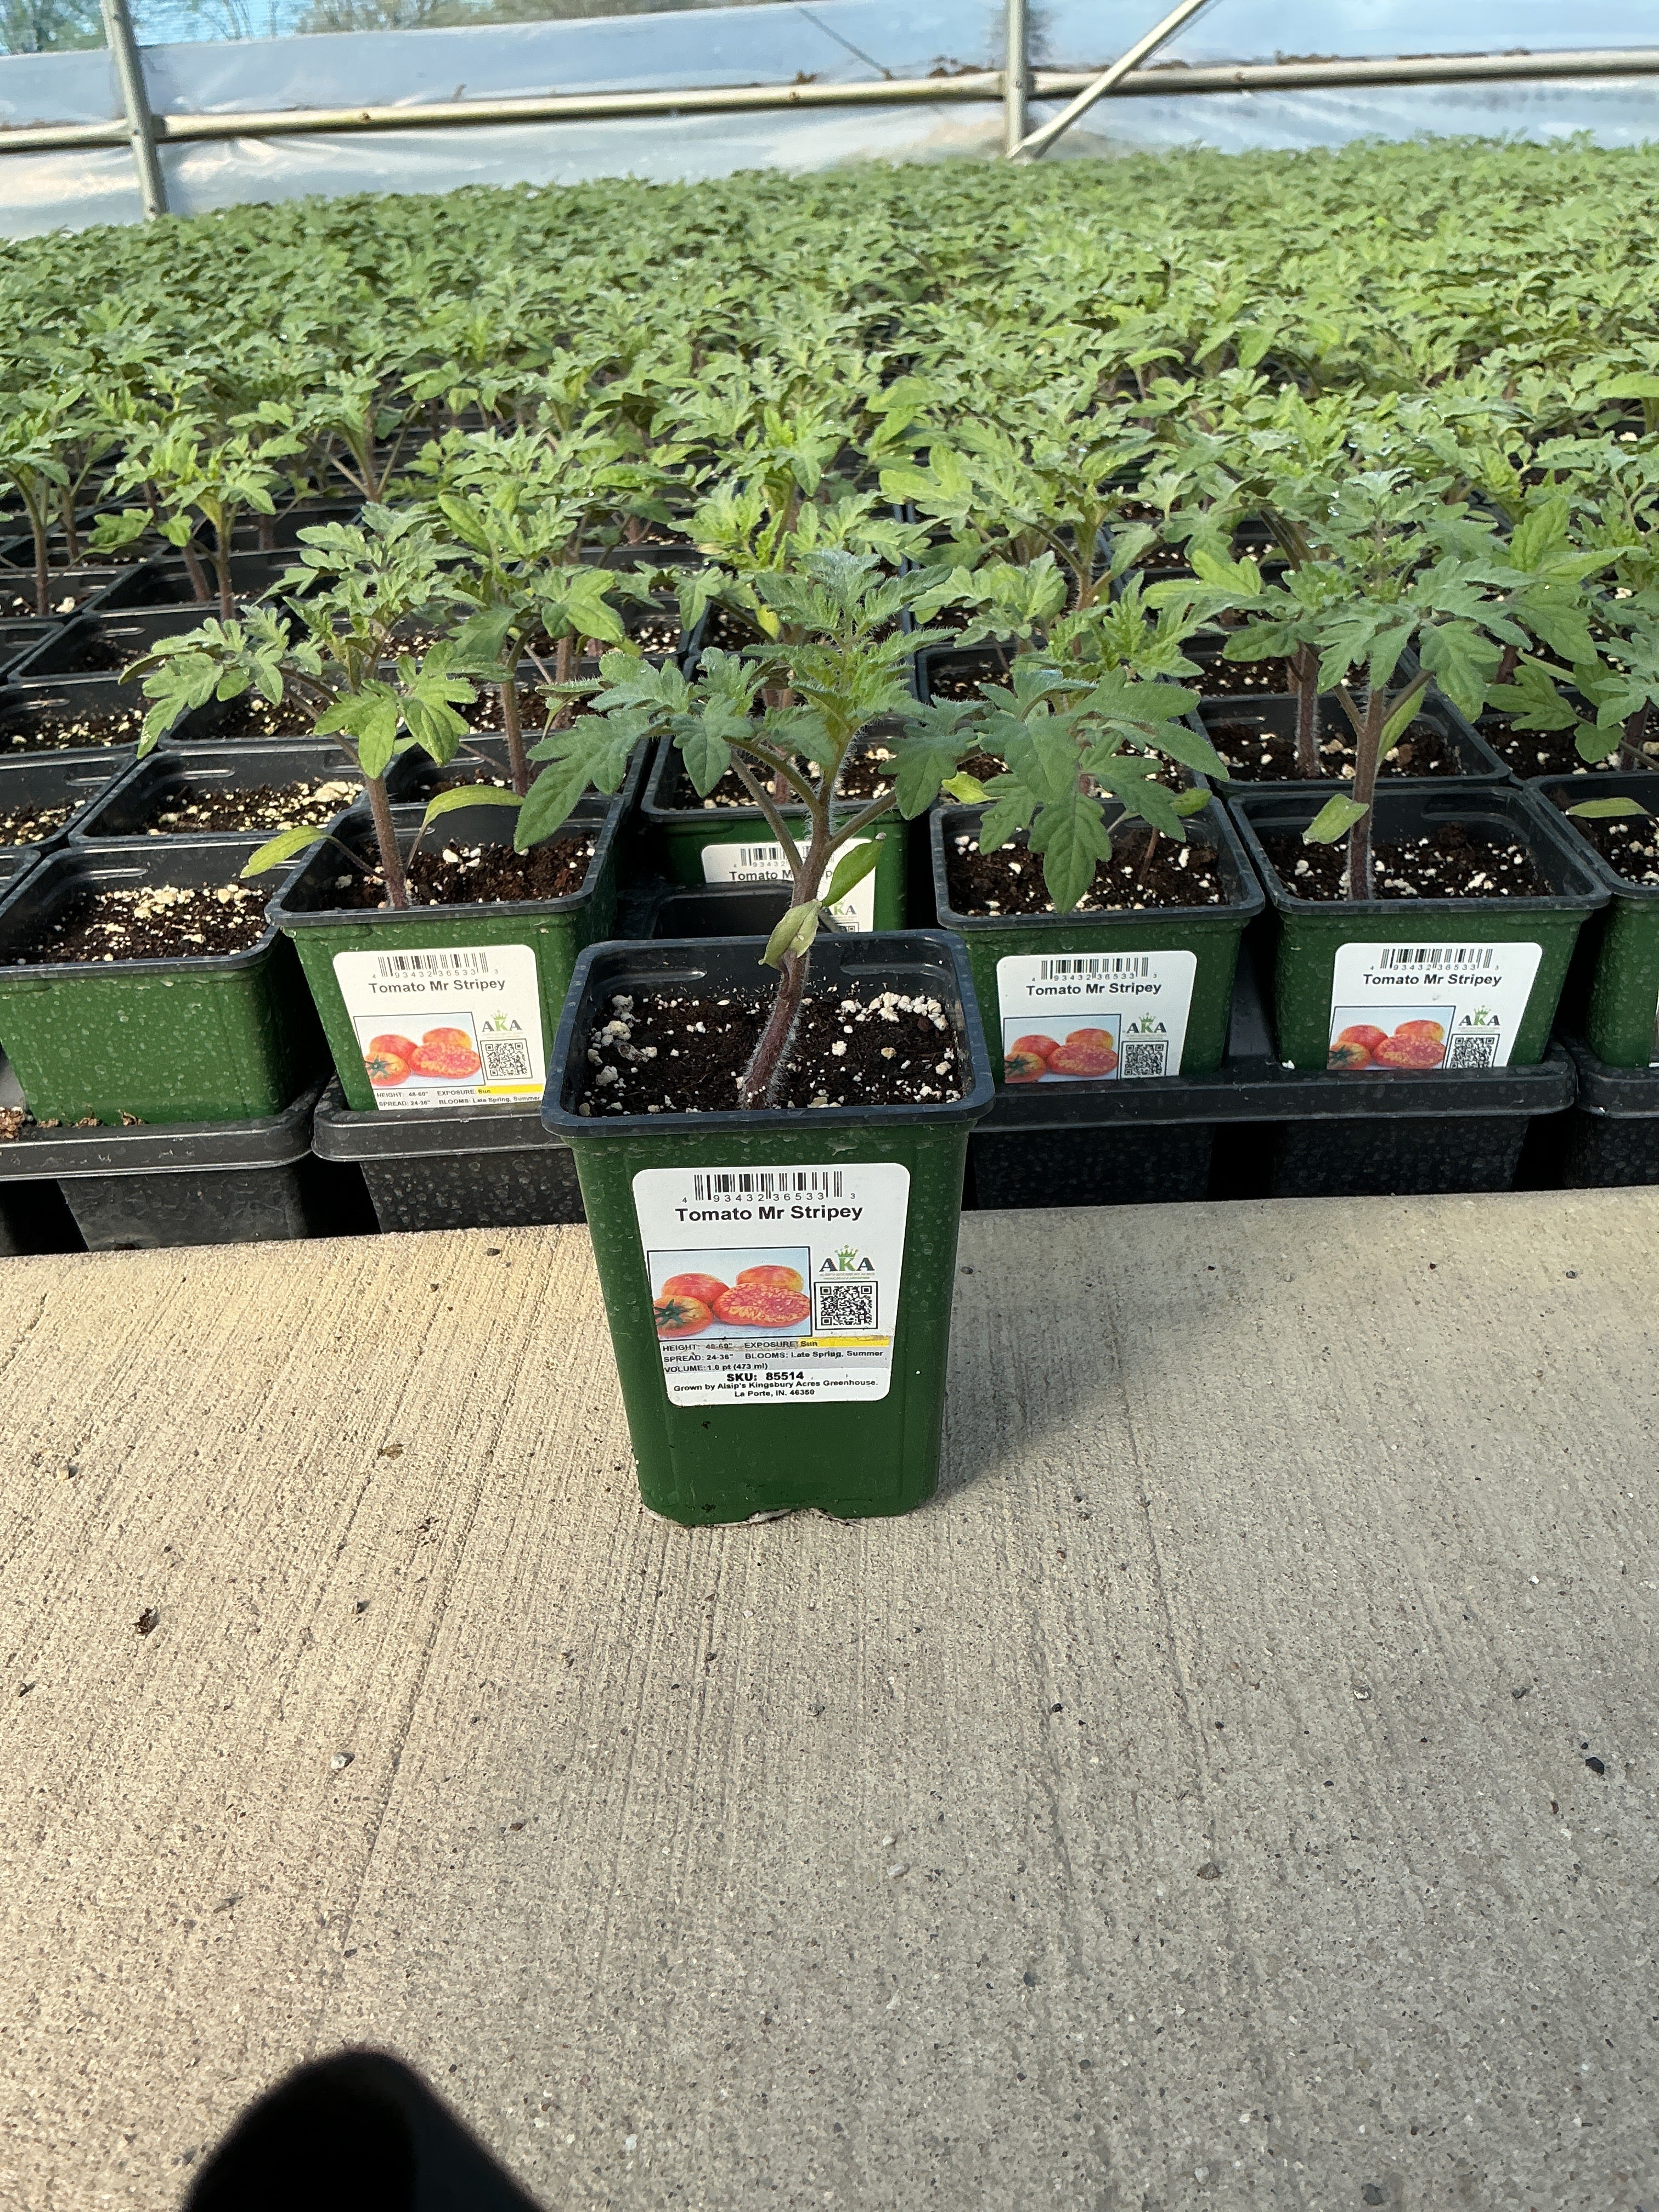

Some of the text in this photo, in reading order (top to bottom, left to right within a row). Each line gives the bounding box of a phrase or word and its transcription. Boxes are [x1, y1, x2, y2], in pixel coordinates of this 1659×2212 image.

[729, 871, 777, 881] Tomato
[368, 979, 505, 994] Tomato Mr Stripey
[1363, 974, 1502, 987] Tomato Mr Stripey
[1026, 983, 1162, 996] Tomato Mr Stripey
[482, 1020, 523, 1032] AKA
[1459, 1014, 1500, 1026] AKA
[1126, 1022, 1167, 1034] AKA
[713, 1193, 764, 1202] 93432
[773, 1192, 824, 1201] 36533
[675, 1205, 864, 1221] Tomato Mr Stripey
[819, 1257, 875, 1272] AKA
[663, 1355, 704, 1363] SPREAD:
[812, 1351, 844, 1359] Spring,
[726, 1372, 804, 1381] SKU: 85514
[705, 1384, 715, 1392] by
[749, 1381, 794, 1390] Kingsbury
